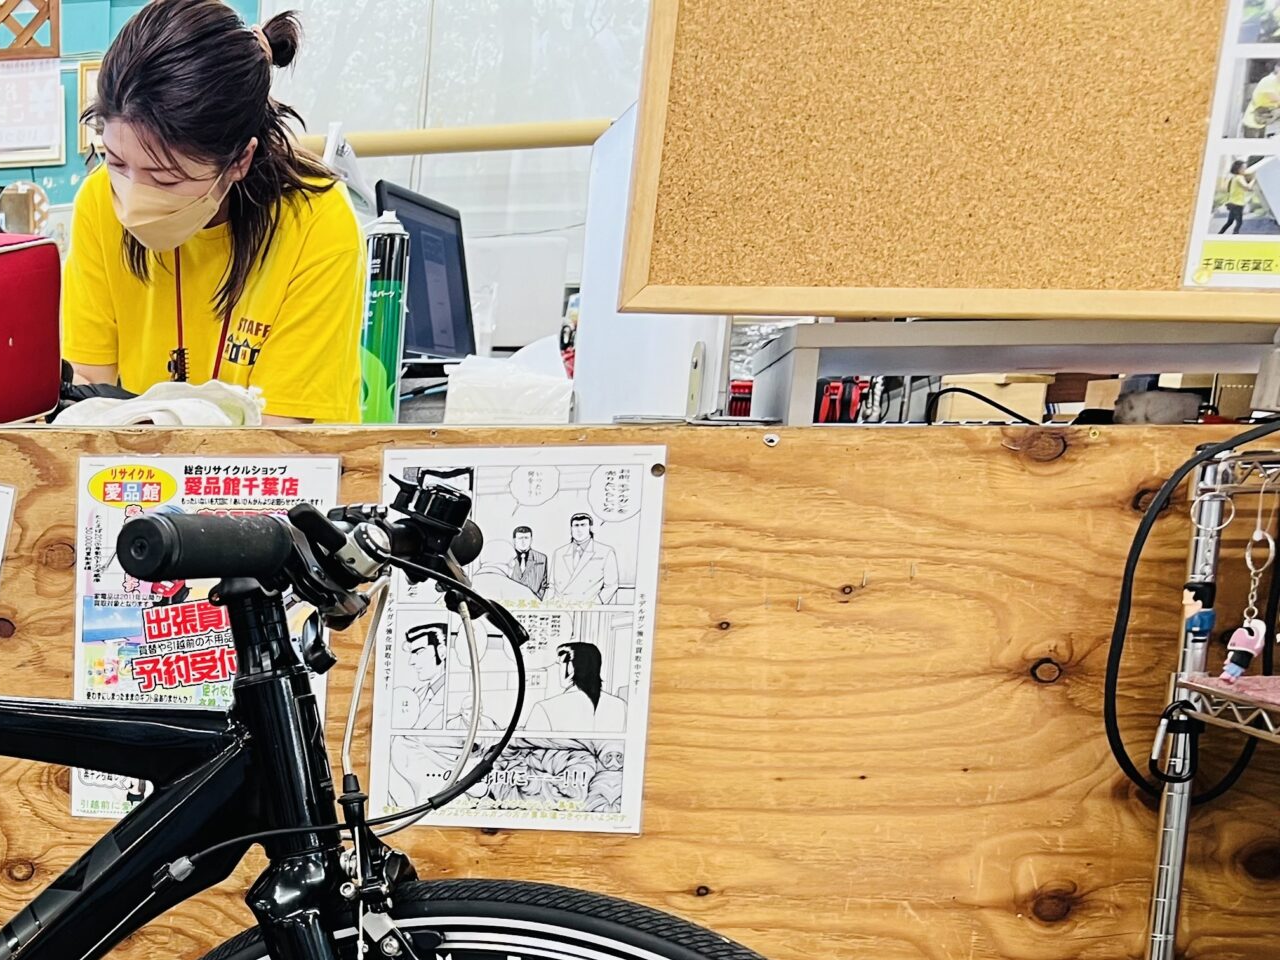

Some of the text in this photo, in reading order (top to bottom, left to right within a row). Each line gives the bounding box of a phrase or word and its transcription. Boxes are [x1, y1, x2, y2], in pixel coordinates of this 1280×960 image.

[237, 317, 271, 339] STAFF
[110, 467, 156, 481] リサイクル
[184, 465, 288, 476] 総合リサイクルショップ
[104, 481, 162, 503] 愛品館
[184, 477, 299, 497] 愛品館千葉店
[144, 602, 231, 641] 出張買
